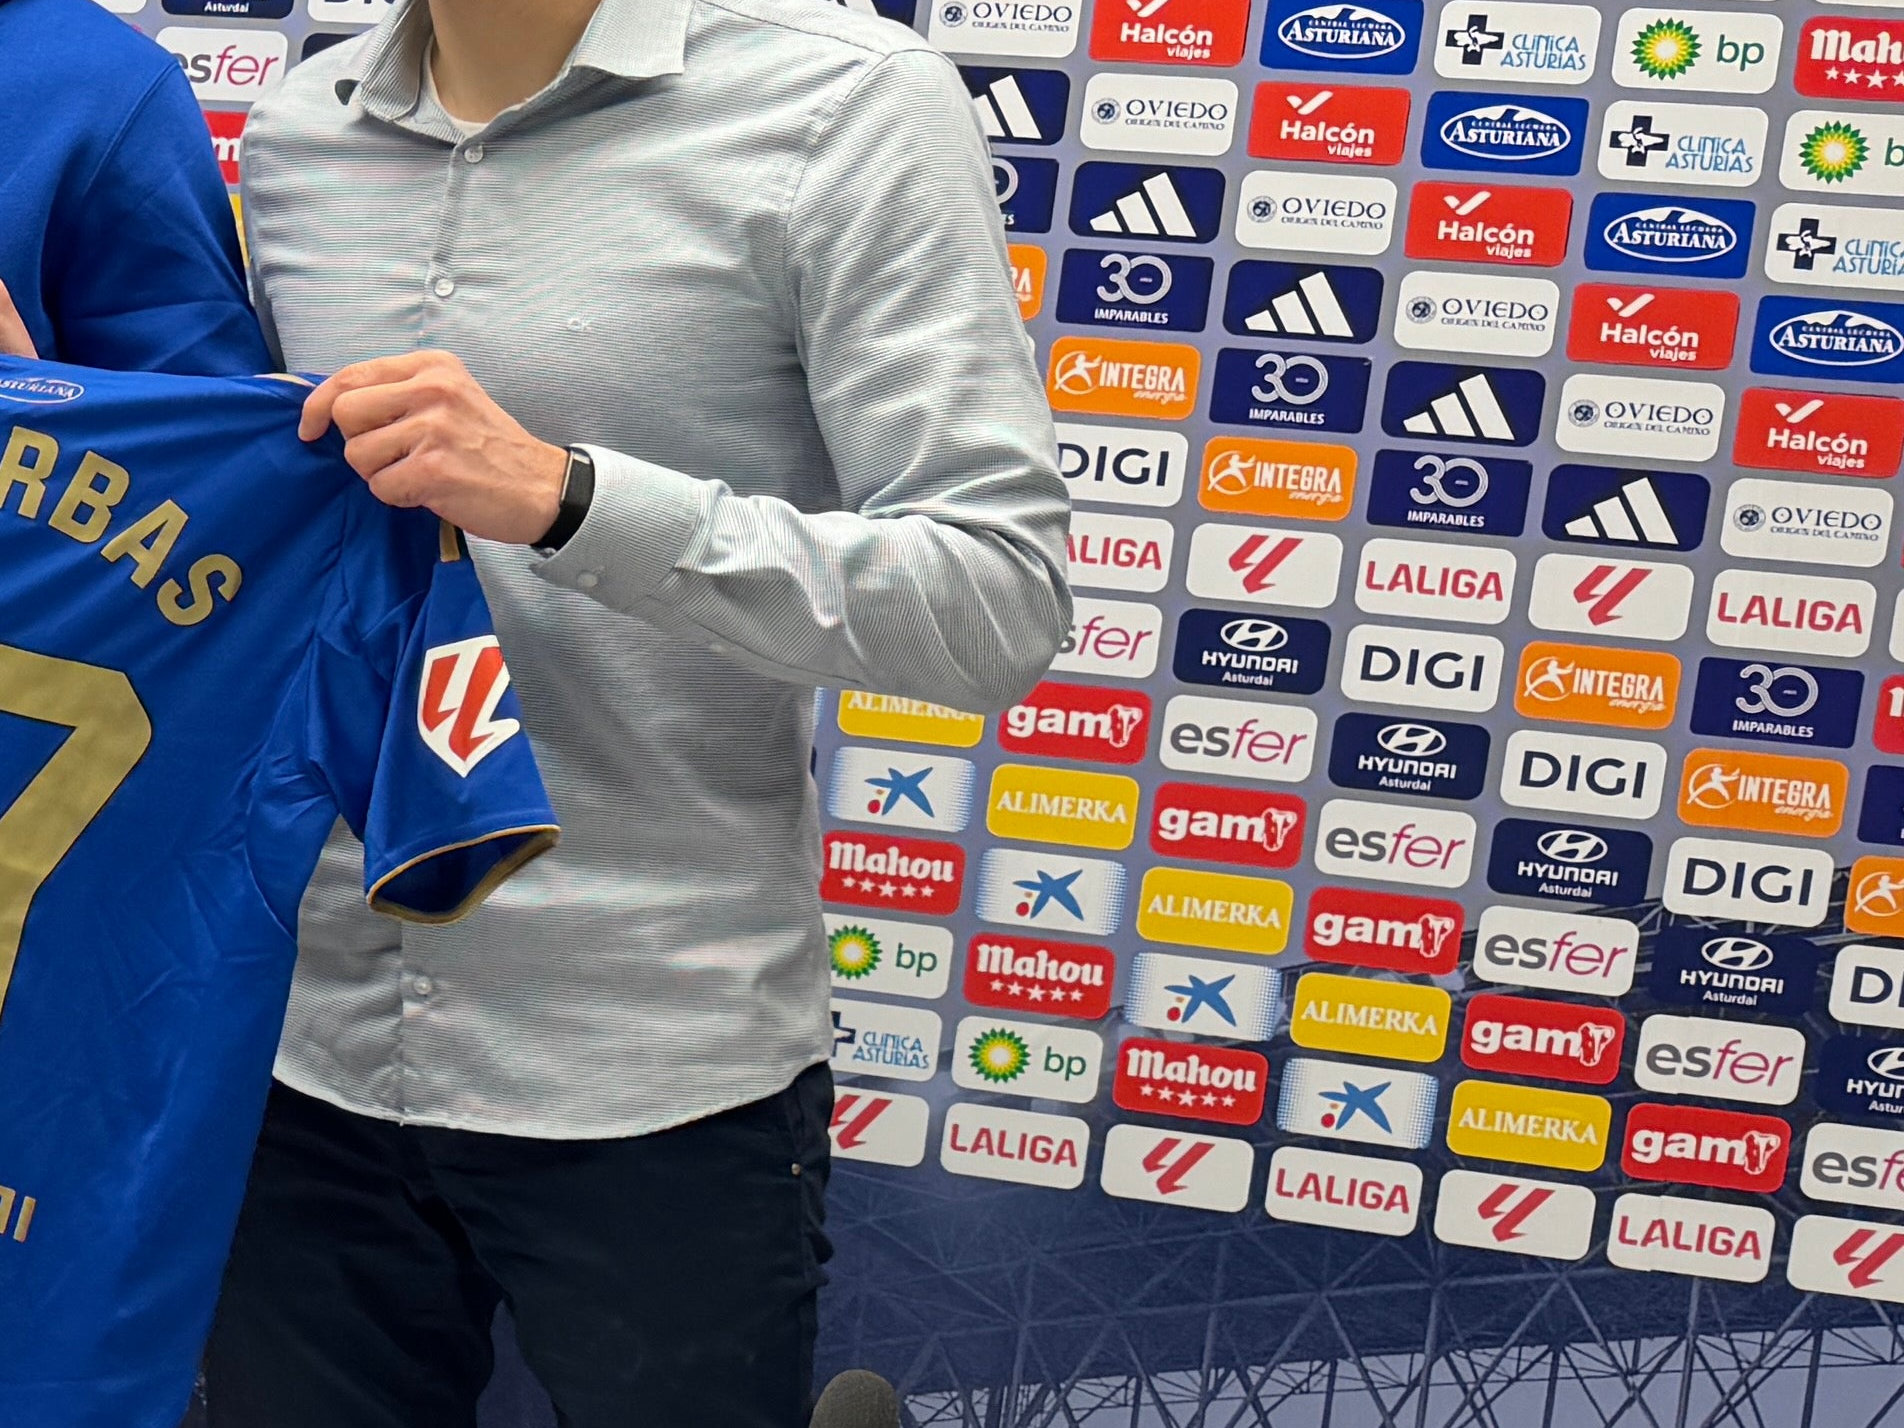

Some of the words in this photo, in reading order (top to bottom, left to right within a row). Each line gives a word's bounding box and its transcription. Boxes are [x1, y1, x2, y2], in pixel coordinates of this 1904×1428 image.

[972, 2, 1072, 25] OVIEDO
[1121, 23, 1212, 46] Halcón
[1285, 20, 1397, 48] ASTURIANA
[1168, 44, 1212, 60] viajes
[1717, 36, 1764, 71] bp
[1282, 198, 1386, 221] OVIEDO
[1438, 221, 1534, 247] Halcón
[1487, 244, 1533, 259] viajes
[1097, 252, 1176, 304] 30
[1094, 308, 1168, 326] IMPARABLES
[1775, 322, 1895, 356] ASTURIANA
[1768, 428, 1867, 455] Halcón
[1252, 459, 1341, 493] INTEGRA
[1818, 452, 1867, 469] viajes
[1771, 507, 1882, 532] OVIEDO
[1366, 561, 1503, 601] LALIGA
[1718, 593, 1862, 634] LALIGA
[1202, 648, 1298, 675] HYUNDAI
[1361, 645, 1484, 691] DIGI
[1219, 671, 1275, 688] Asturdai
[1570, 667, 1664, 704] INTEGRA
[1736, 661, 1821, 716] 30
[1005, 701, 1108, 738] gam
[1730, 720, 1813, 740] IMPARABLES
[1166, 713, 1311, 767] esfer
[1358, 752, 1456, 781] HYUNDAI
[1520, 751, 1646, 798] DIGI
[1377, 775, 1433, 793] Asturdai
[997, 791, 1127, 823] ALIMERKA
[830, 838, 956, 885] Mahou
[896, 943, 937, 977] bp
[1481, 931, 1628, 981] esfer
[1681, 964, 1783, 997] HYUNDAI
[1646, 1027, 1796, 1086] esfer
[1459, 1108, 1597, 1144] ALIMERKA
[950, 1124, 1077, 1167] LALIGA
[1632, 1130, 1744, 1170] gam
[1618, 1216, 1761, 1260] LALIGA
